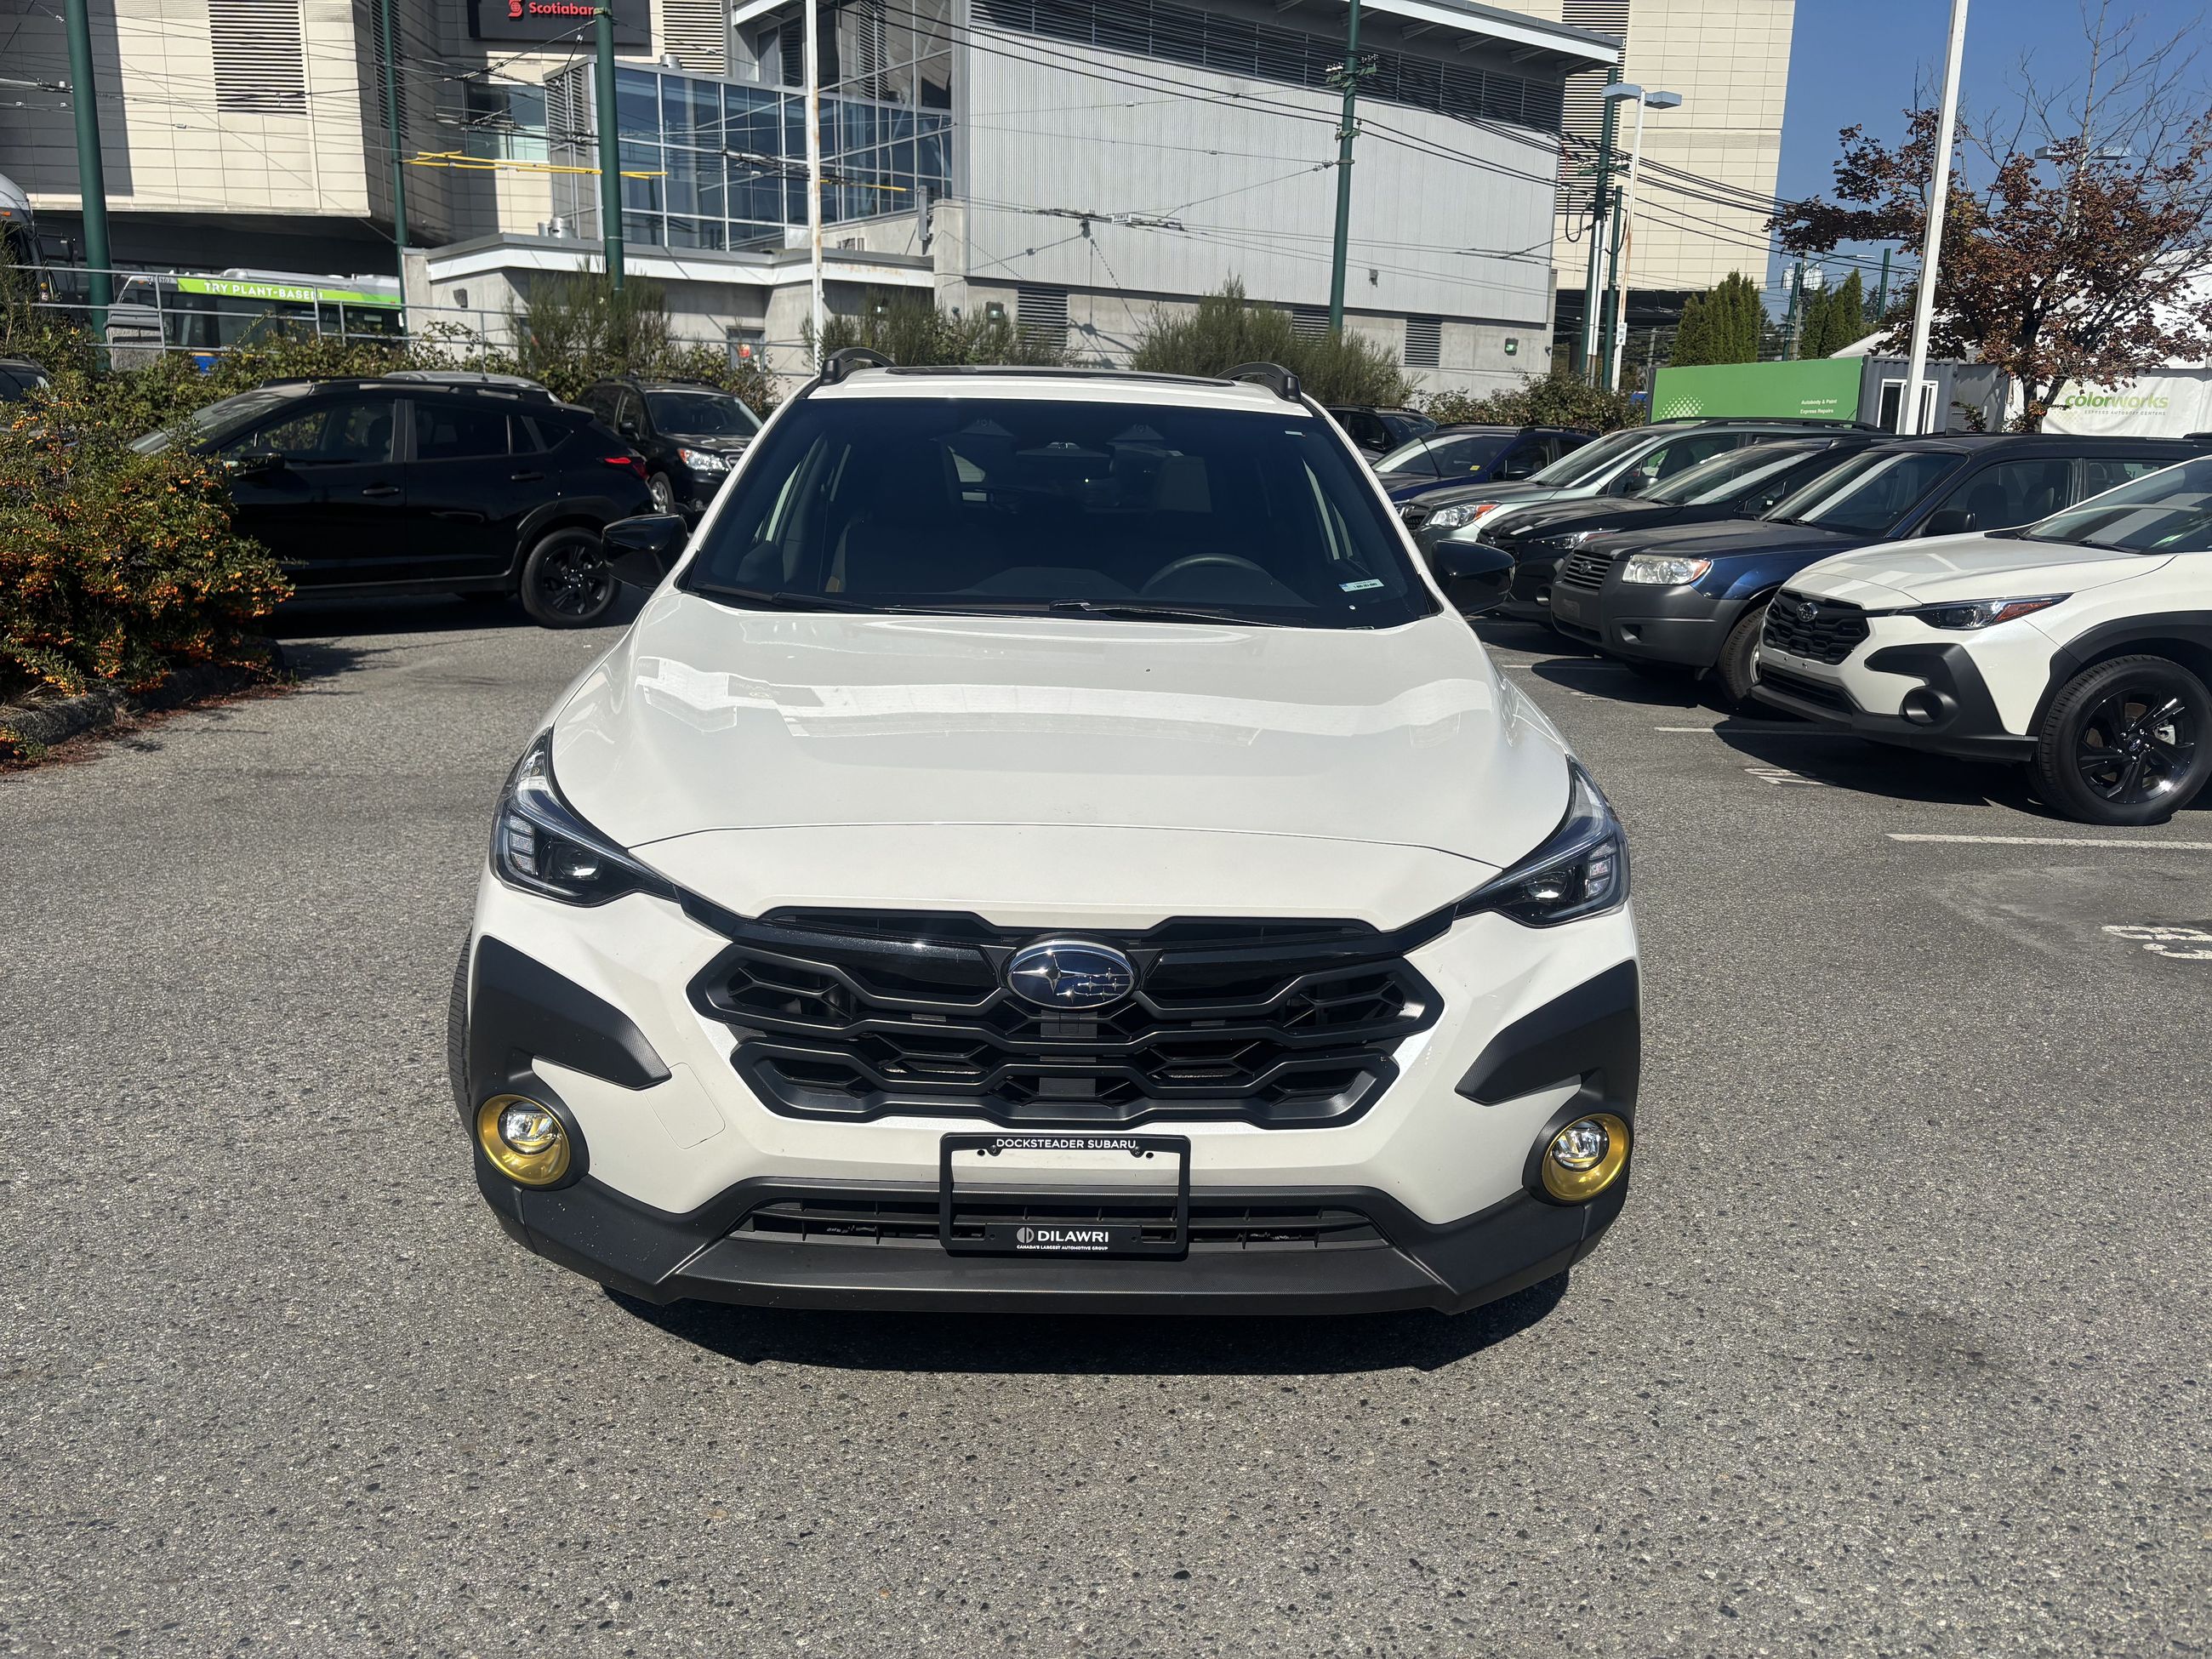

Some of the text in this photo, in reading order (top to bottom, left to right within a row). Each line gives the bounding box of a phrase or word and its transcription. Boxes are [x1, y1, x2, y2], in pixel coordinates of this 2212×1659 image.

[528, 2, 596, 15] Scotiaban
[204, 282, 228, 294] TRY
[2065, 391, 2169, 408] colorworks
[996, 1138, 1137, 1149] DOCKSTEADER SUBARU
[1037, 1230, 1109, 1243] DILAWRI
